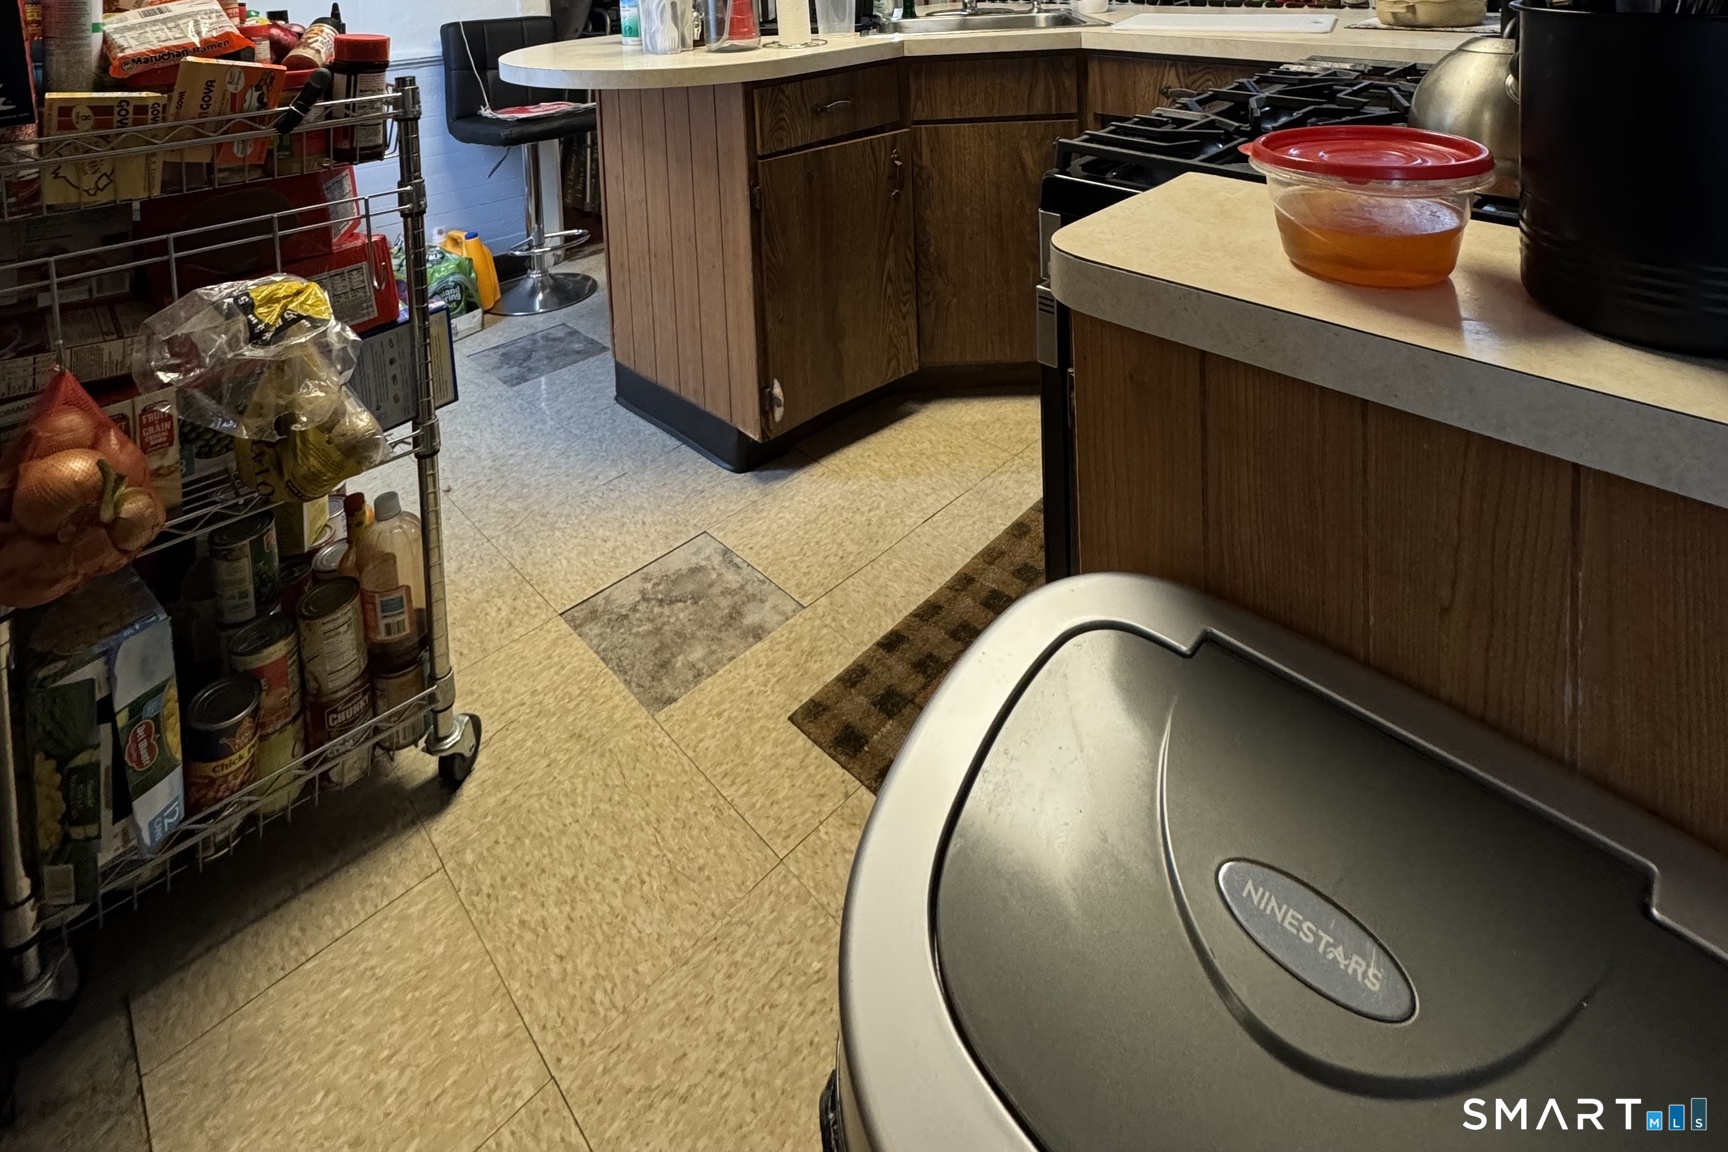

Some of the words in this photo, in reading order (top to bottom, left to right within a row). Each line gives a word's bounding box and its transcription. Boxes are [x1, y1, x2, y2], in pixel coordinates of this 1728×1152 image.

[131, 48, 189, 65] Maruchan
[192, 39, 230, 54] Ramen
[176, 91, 186, 110] GOYA
[200, 79, 216, 111] GOYA
[117, 99, 130, 128] GOY
[150, 102, 161, 124] GOY
[142, 421, 171, 436] GRAIN
[328, 694, 371, 727] CHUNKY
[212, 755, 244, 773] Chick
[164, 802, 180, 831] 12
[1242, 878, 1384, 993] NINESTARS
